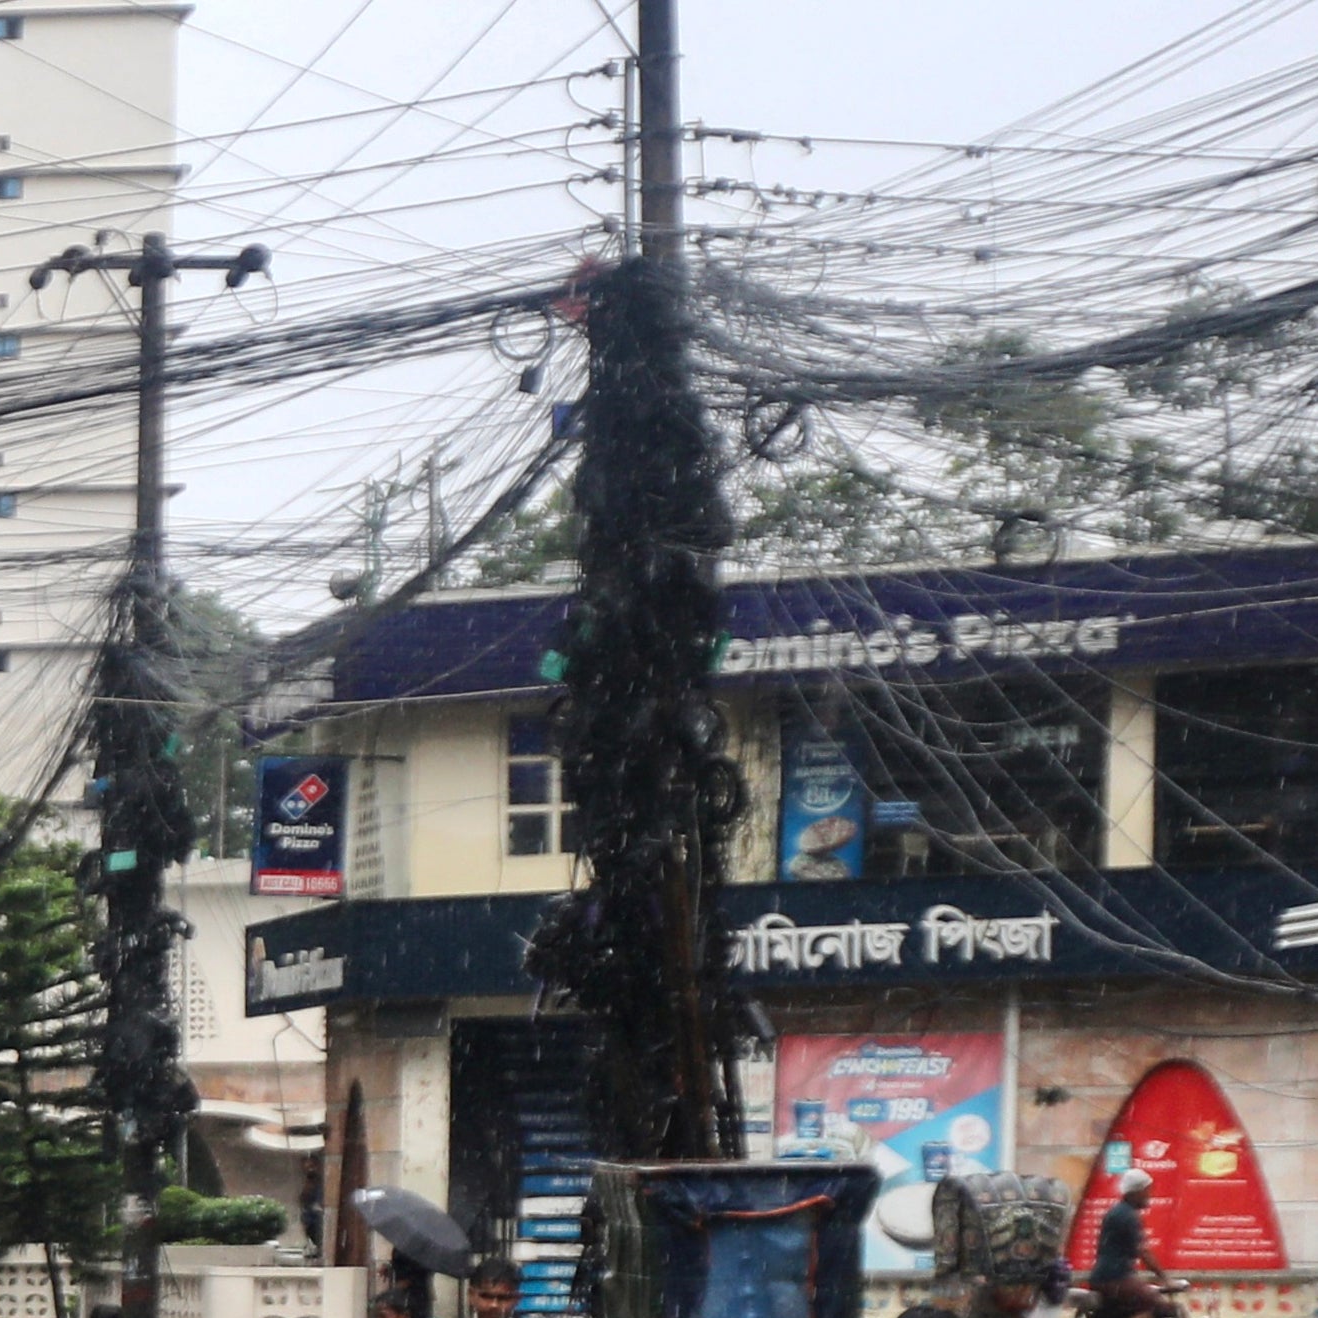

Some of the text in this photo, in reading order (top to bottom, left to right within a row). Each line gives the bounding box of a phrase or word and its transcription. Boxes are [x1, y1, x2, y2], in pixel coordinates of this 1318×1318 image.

[721, 610, 1120, 674] omino's Pizza
[270, 822, 334, 836] Domino's
[282, 836, 320, 849] Pizza
[888, 1097, 929, 1121] 199
